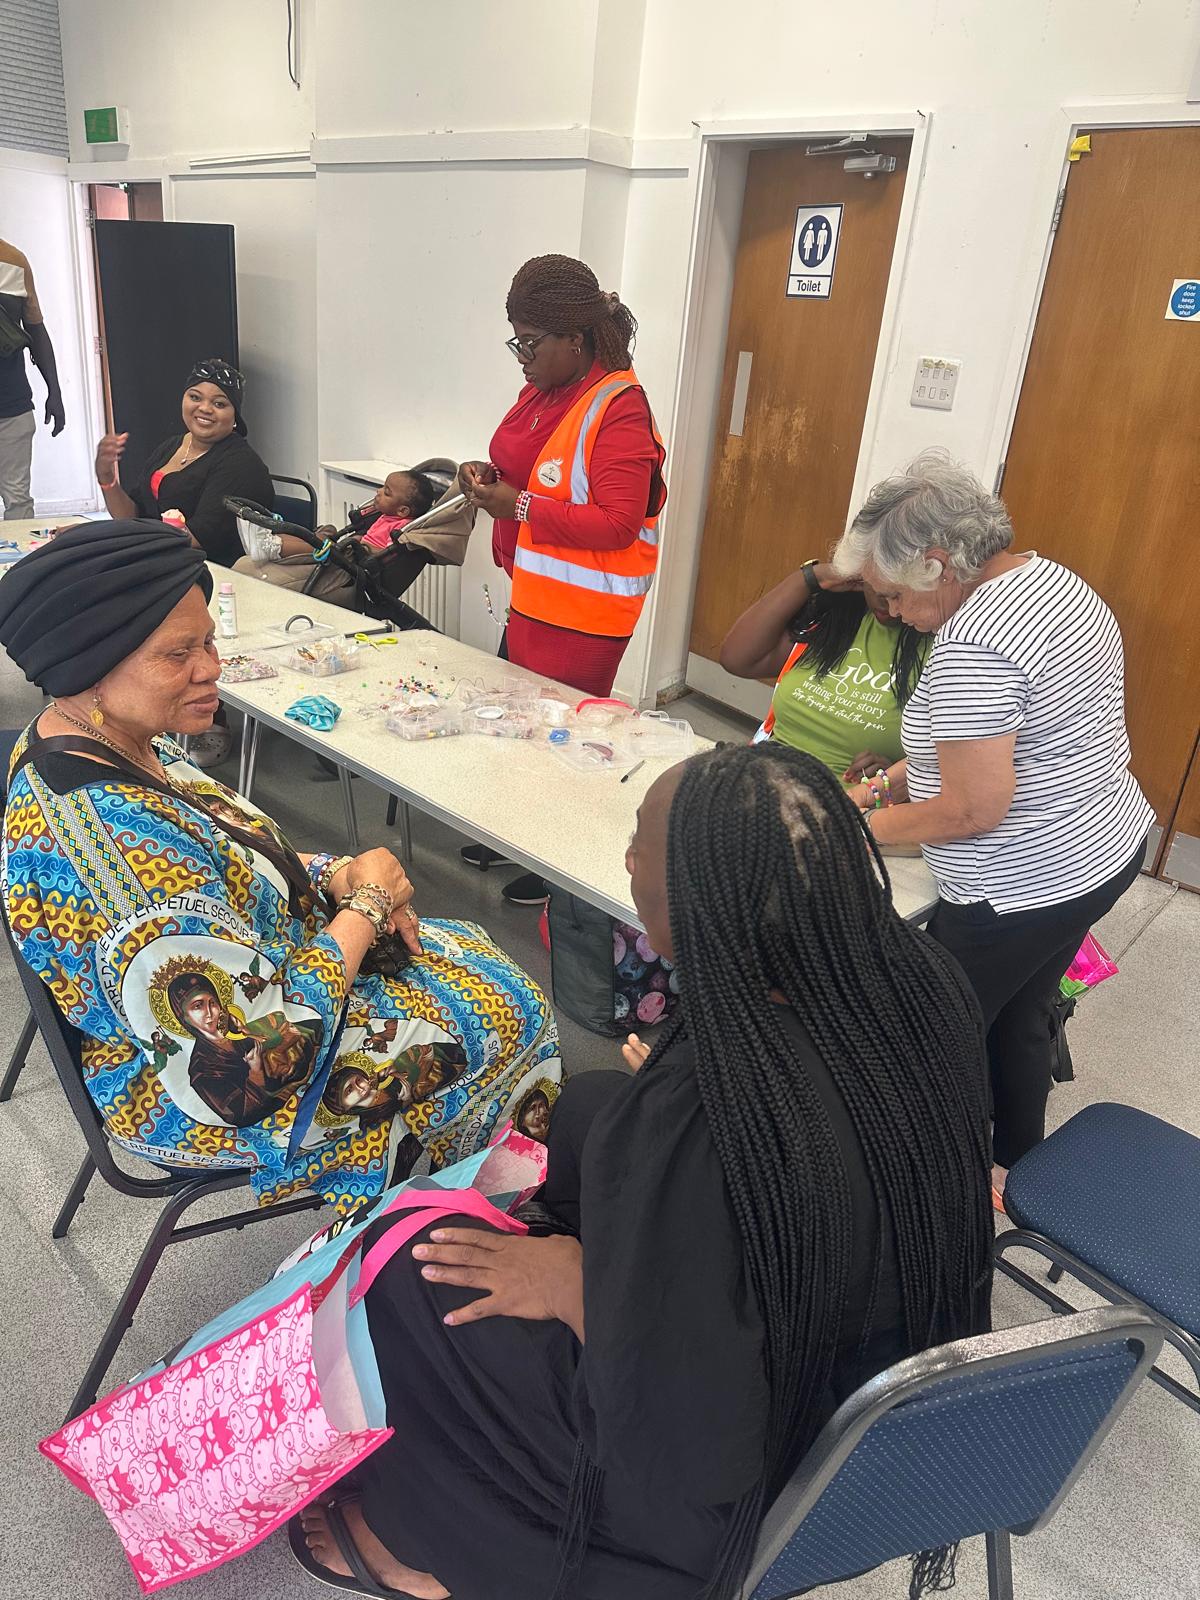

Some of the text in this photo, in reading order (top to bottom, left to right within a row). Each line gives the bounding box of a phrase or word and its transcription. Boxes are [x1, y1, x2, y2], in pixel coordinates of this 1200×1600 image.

[797, 280, 821, 292] Toilet
[826, 648, 897, 695] God
[802, 680, 887, 719] writing your story
[850, 688, 883, 704] is still
[863, 722, 886, 731] pen
[103, 980, 129, 1025] OTRE
[449, 1070, 477, 1091] POU
[460, 1129, 478, 1158] OTRE
